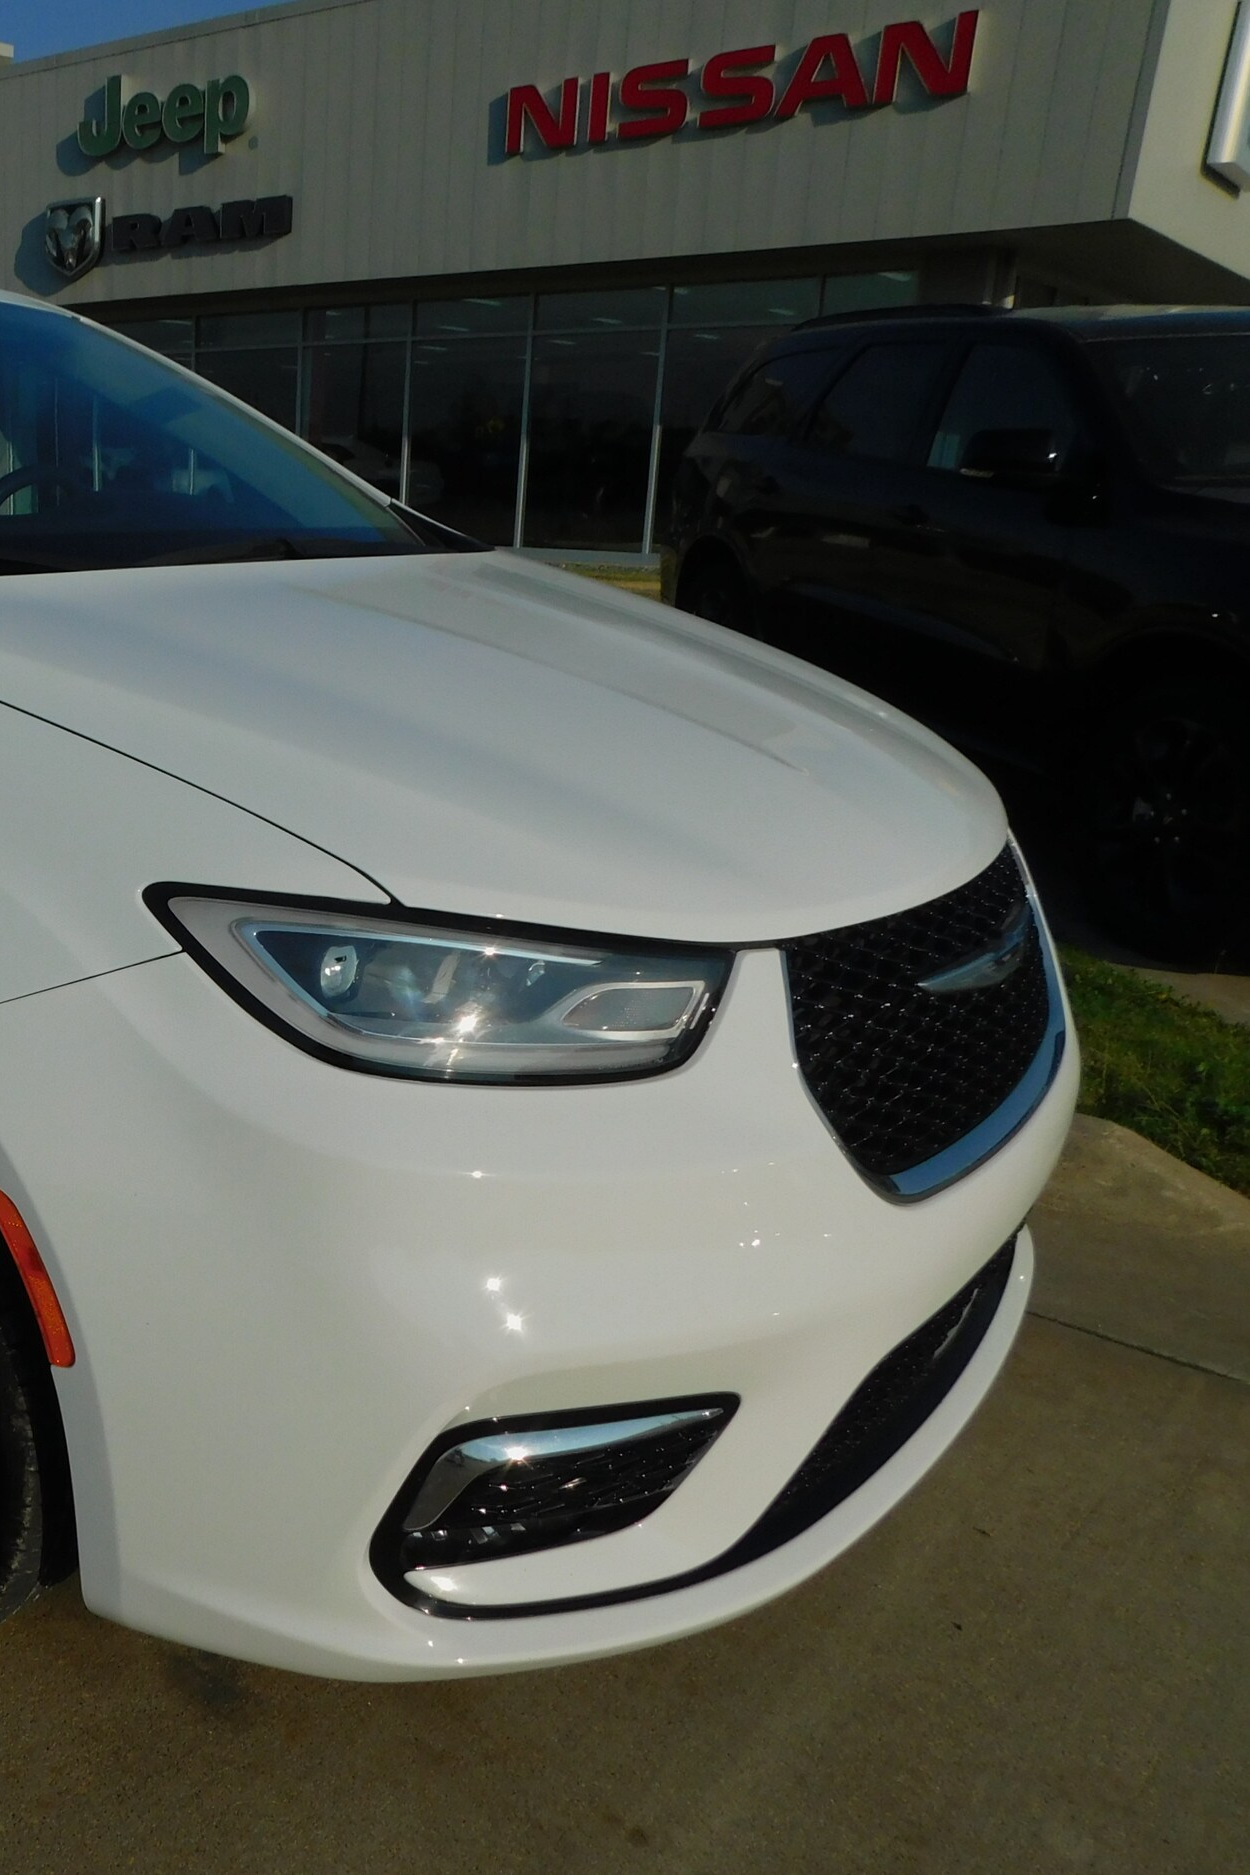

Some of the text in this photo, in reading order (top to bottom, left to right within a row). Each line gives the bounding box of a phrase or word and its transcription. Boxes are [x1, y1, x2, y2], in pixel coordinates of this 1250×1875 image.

[77, 74, 252, 157] Jeep
[505, 9, 980, 155] NISSAN
[112, 194, 293, 251] RAM
